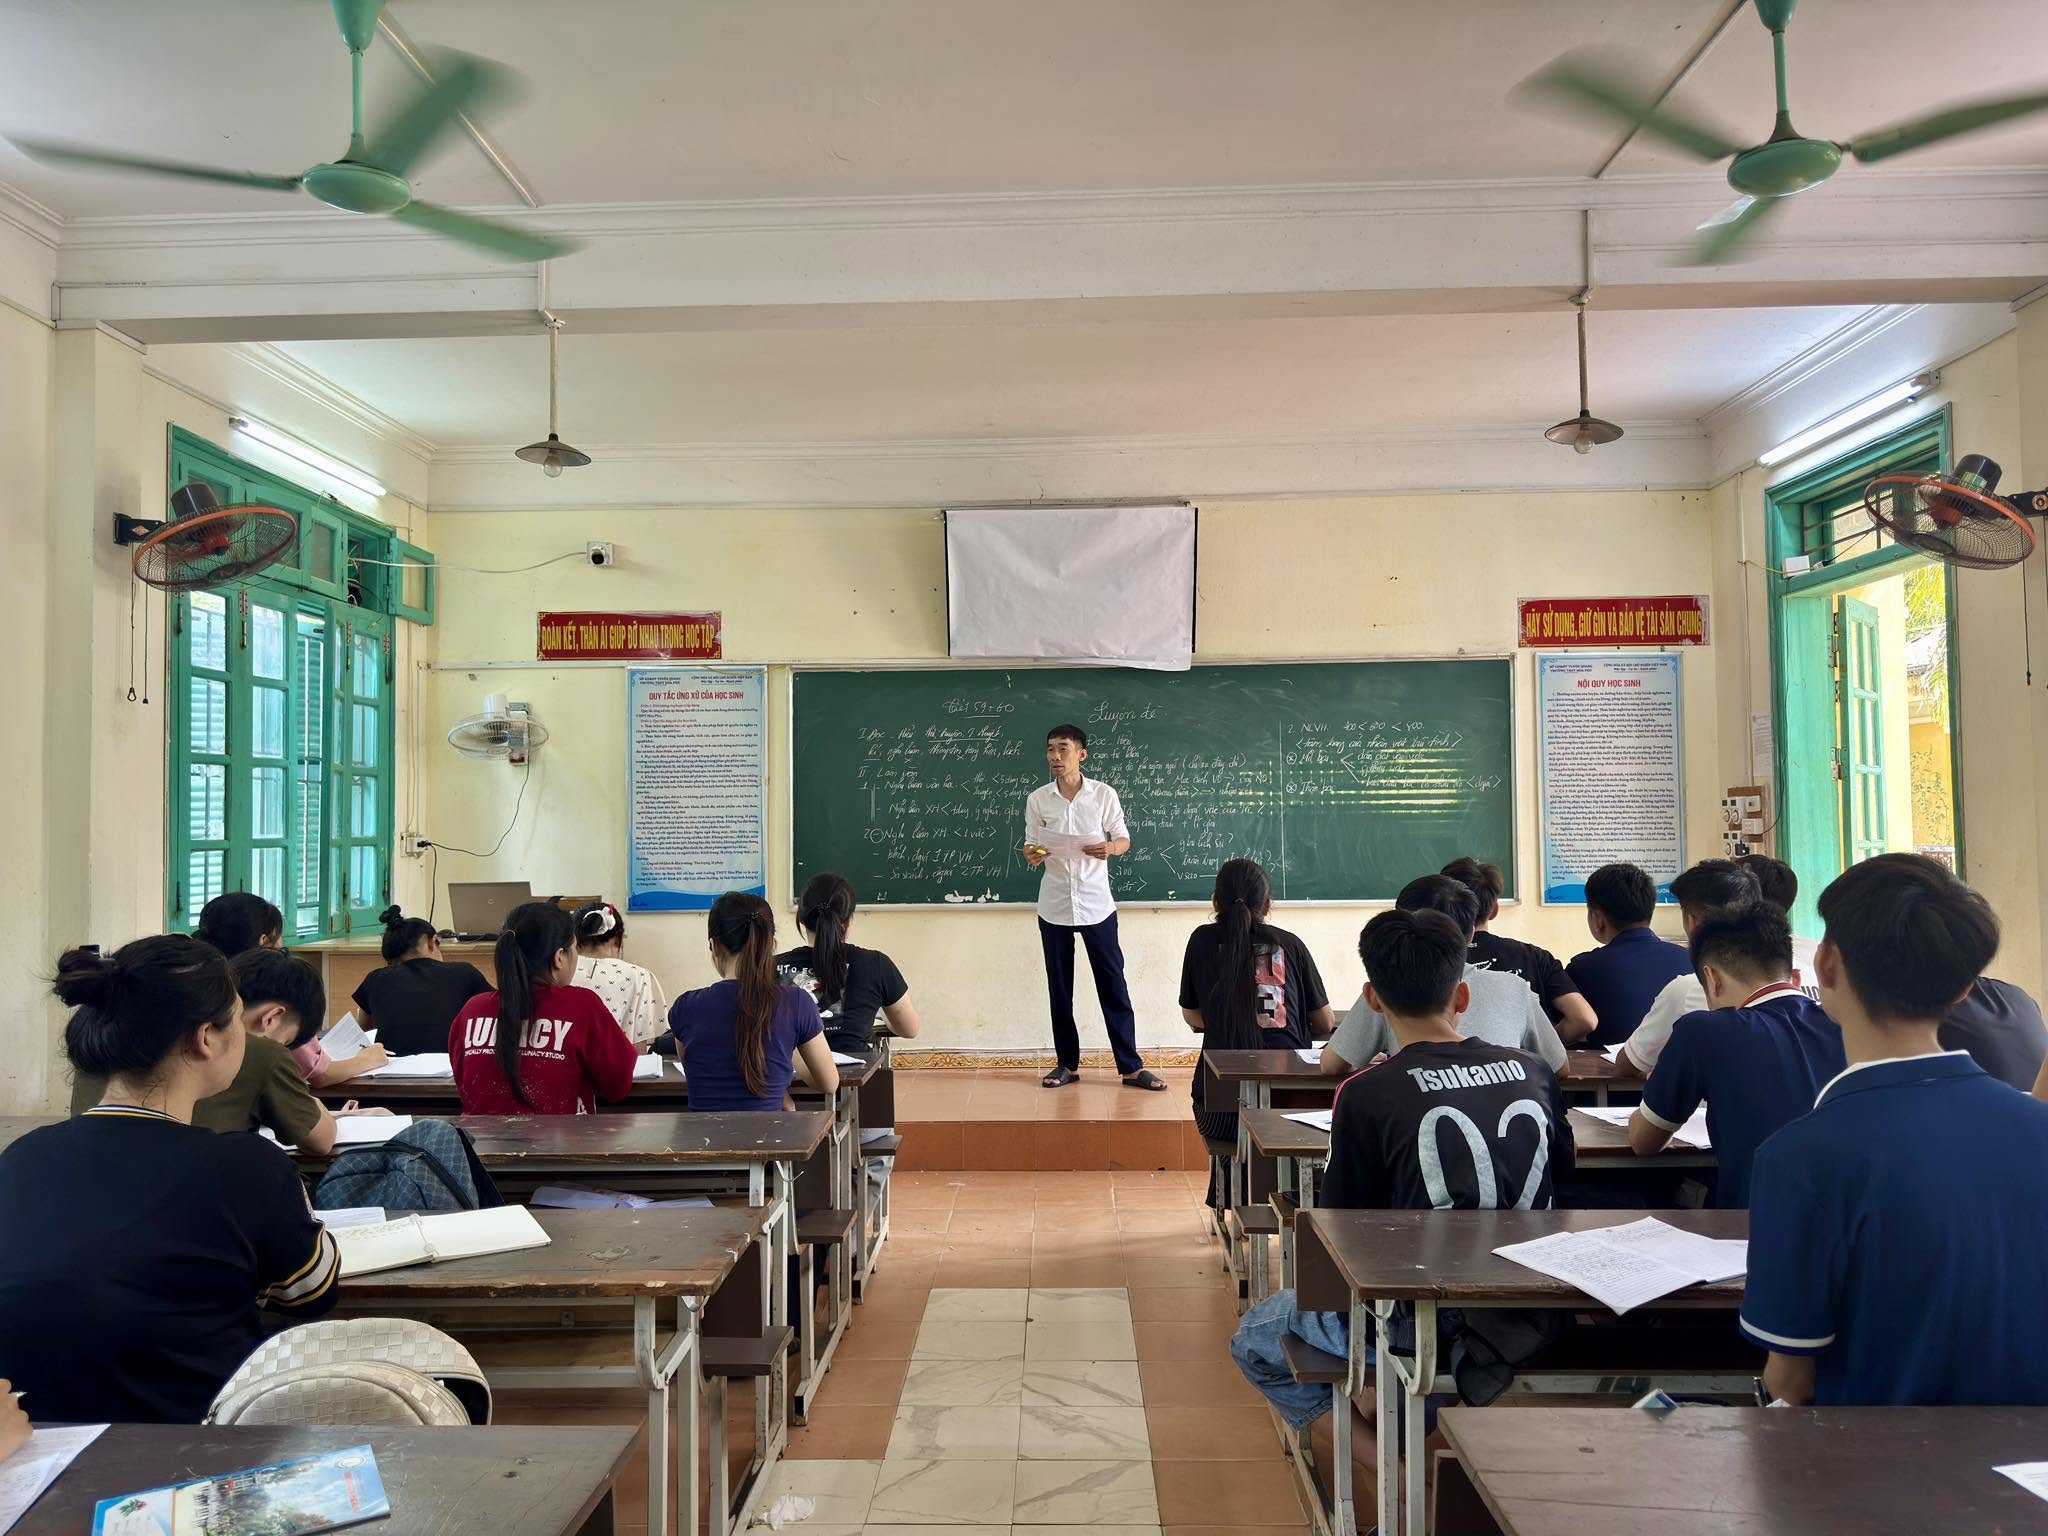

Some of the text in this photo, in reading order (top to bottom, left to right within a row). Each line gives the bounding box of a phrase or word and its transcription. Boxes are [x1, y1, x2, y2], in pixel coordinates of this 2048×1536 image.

[541, 619, 715, 652] ĐOÀN KẾT, THÂN ÁI GIÚP ĐỠ NHAU TRONG HỌC TẬP
[1526, 608, 1540, 637] HÃY
[1542, 603, 1553, 637] SỬ
[1554, 612, 1578, 641] DỤNG,
[1578, 607, 1592, 637] GIỮ
[1592, 606, 1606, 636] GÌN
[1619, 603, 1634, 636] BẢO
[1635, 606, 1645, 640] VỆ
[1646, 605, 1658, 636] TÀI
[1659, 602, 1675, 636] SẢN
[1676, 610, 1703, 636] CHUNG
[648, 690, 744, 701] QUY TẮC ỨNG XỬ CỦA HỌC SINH
[1577, 679, 1641, 689] NỘI QUY HỌC SINH
[776, 964, 798, 975] ЧТО
[465, 1017, 574, 1051] LUCY
[1406, 1059, 1526, 1093] Tsukamo
[1418, 1099, 1552, 1210] 02
